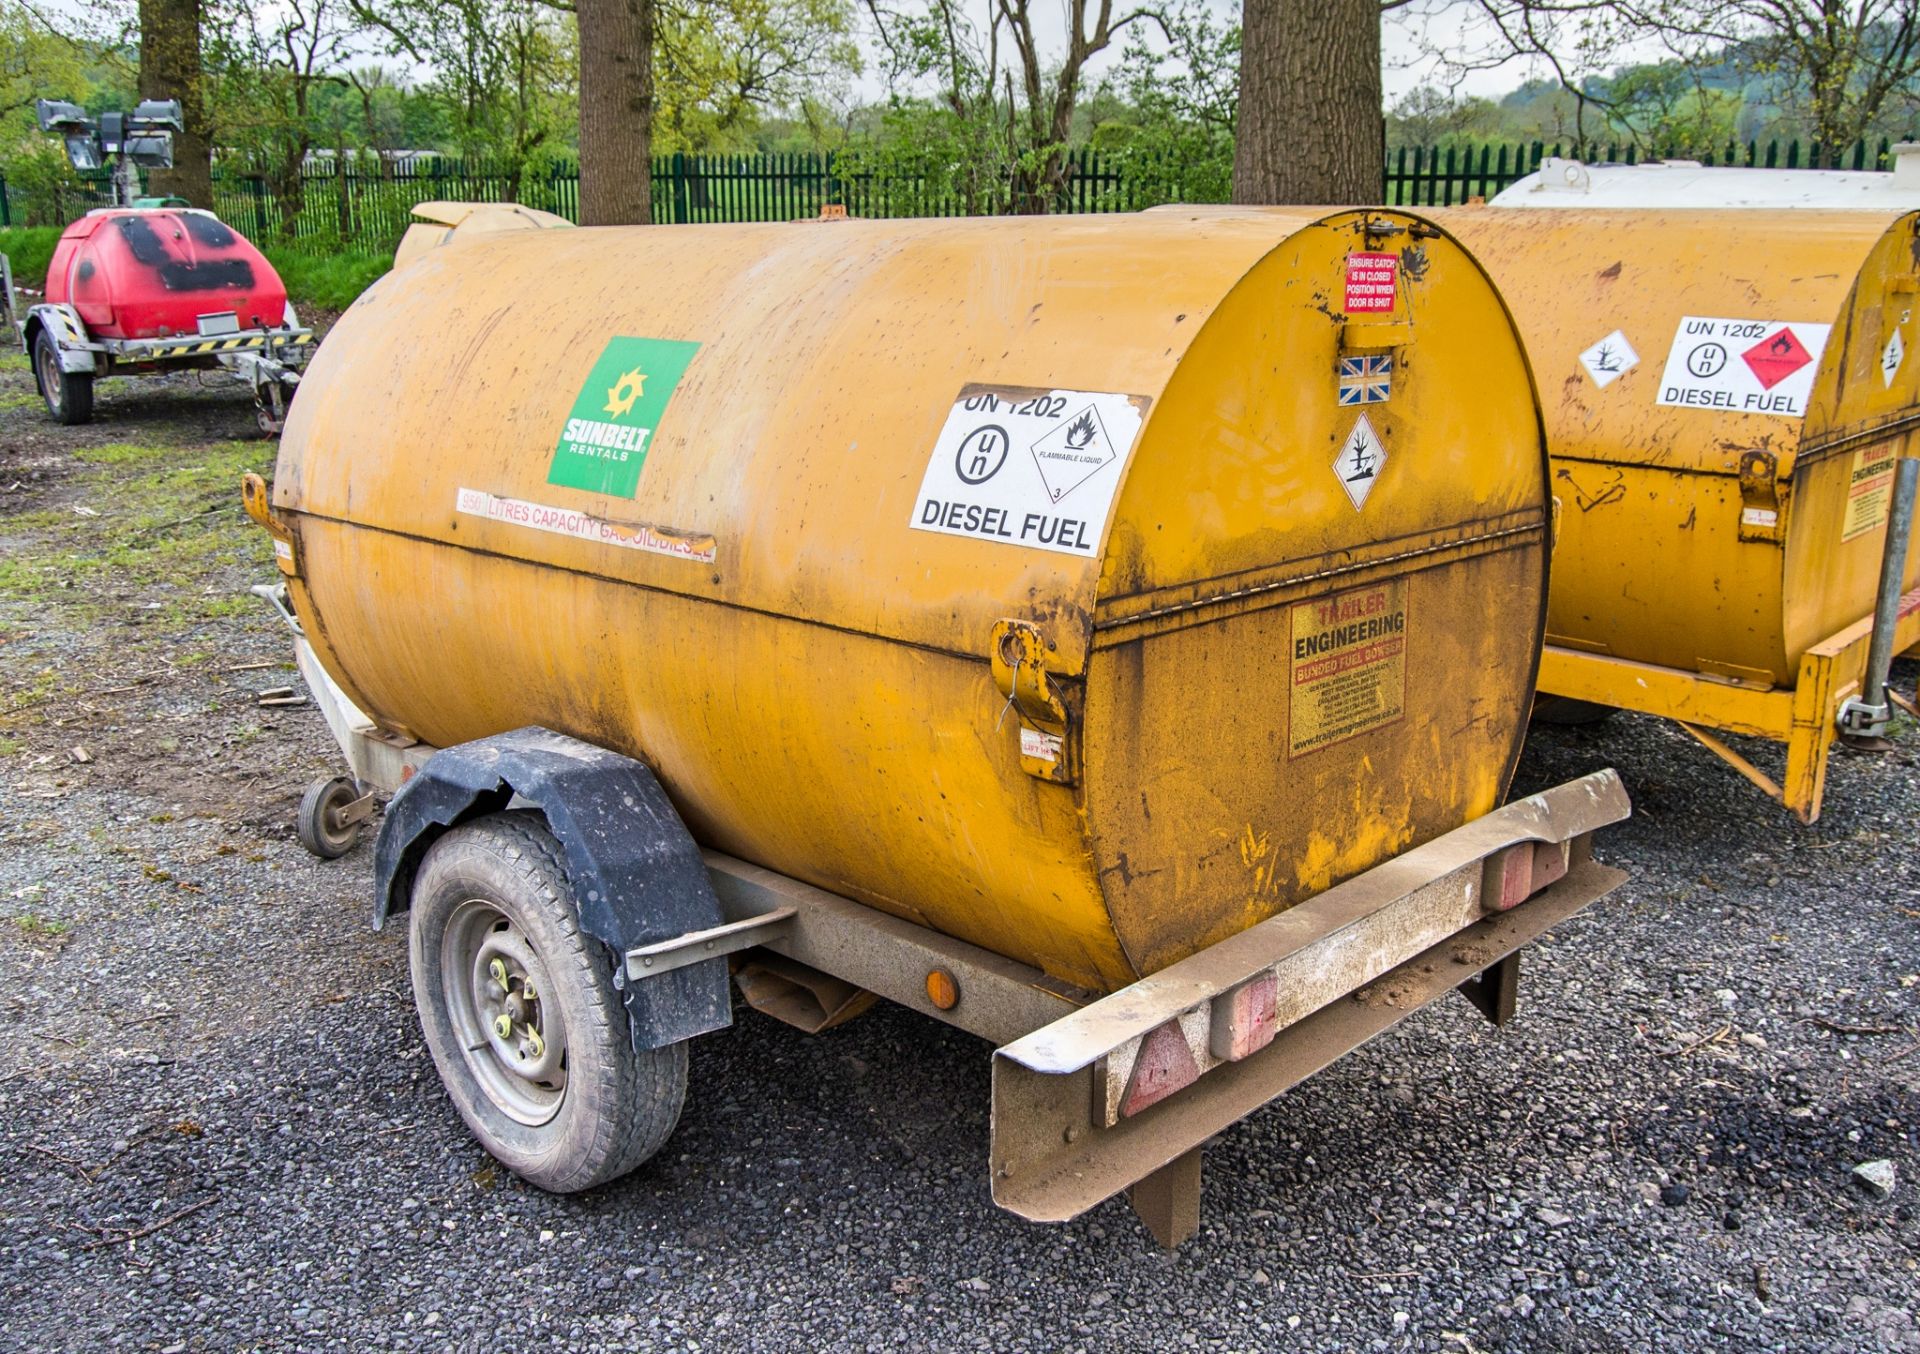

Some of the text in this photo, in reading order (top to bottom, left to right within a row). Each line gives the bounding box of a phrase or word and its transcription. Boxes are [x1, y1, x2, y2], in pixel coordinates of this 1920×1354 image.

[1349, 258, 1396, 268] ENSURE CATCH
[1352, 271, 1391, 281] IS IN CLOSED
[1347, 285, 1394, 294] POSITION WHEN
[1349, 298, 1391, 307] DOOR IS SHUT
[1686, 321, 1766, 338] UN 1202
[965, 393, 999, 413] UN
[1665, 387, 1798, 413] DIESEL FUEL
[569, 444, 629, 462] RENTALS
[1039, 451, 1102, 464] FLAMMABLE LIQUID
[1053, 488, 1061, 498] 3
[488, 499, 529, 521] LITRES
[532, 509, 595, 534] CAPACITY
[921, 499, 1091, 550] DIESEL FUEL
[1319, 592, 1385, 625] TRAILER
[1296, 611, 1404, 659] ENGINEERING
[1340, 652, 1362, 672] FUEL
